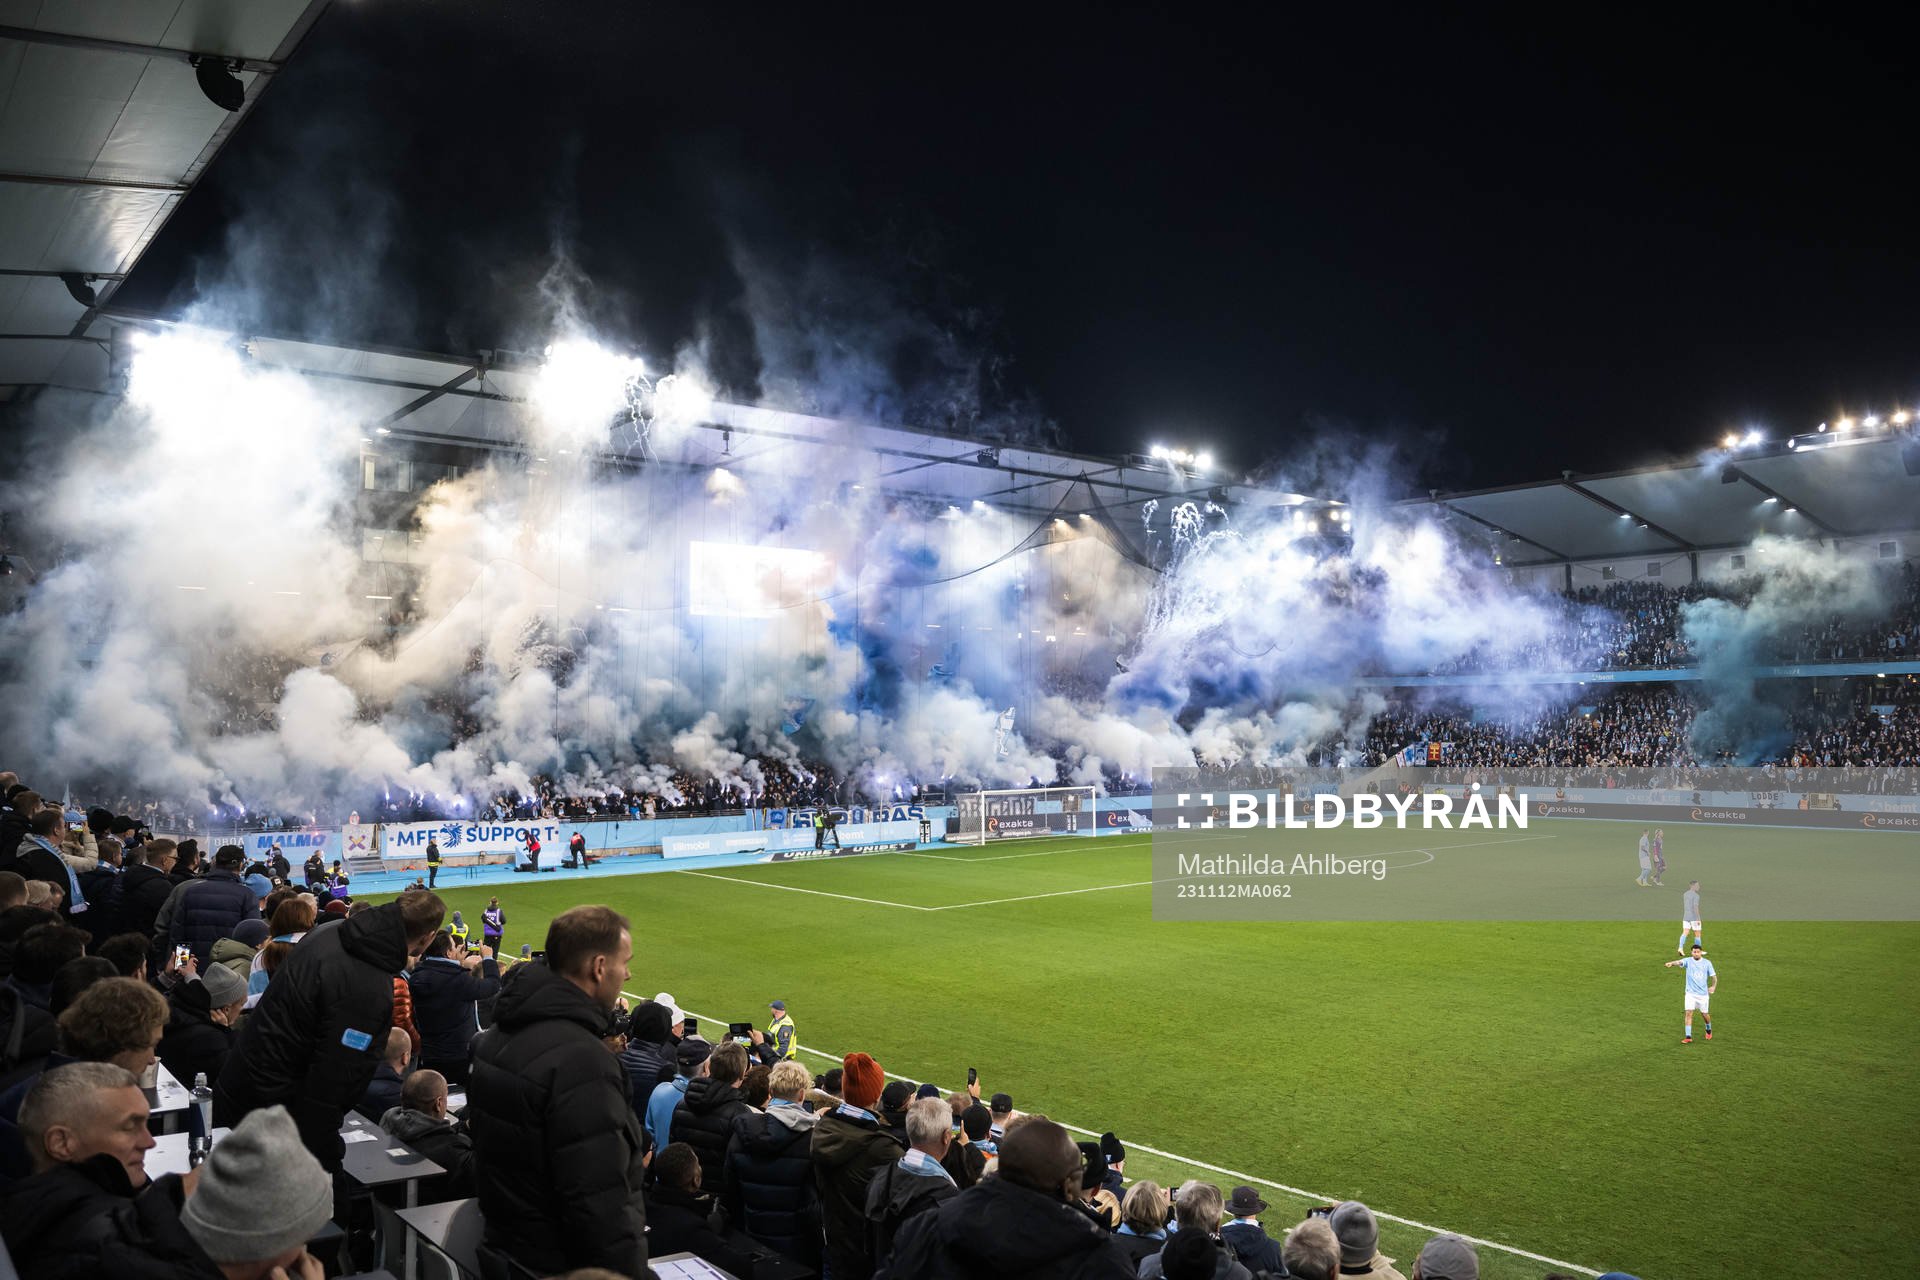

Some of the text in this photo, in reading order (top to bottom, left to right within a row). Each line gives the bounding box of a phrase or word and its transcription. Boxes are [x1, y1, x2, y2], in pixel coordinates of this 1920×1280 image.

[1550, 805, 1586, 815] exakta
[1703, 810, 1746, 820] exakta
[999, 819, 1034, 829] exakta
[1877, 816, 1920, 827] exakt
[396, 829, 438, 847] MFF
[783, 842, 909, 858] UNIBET UNIBET
